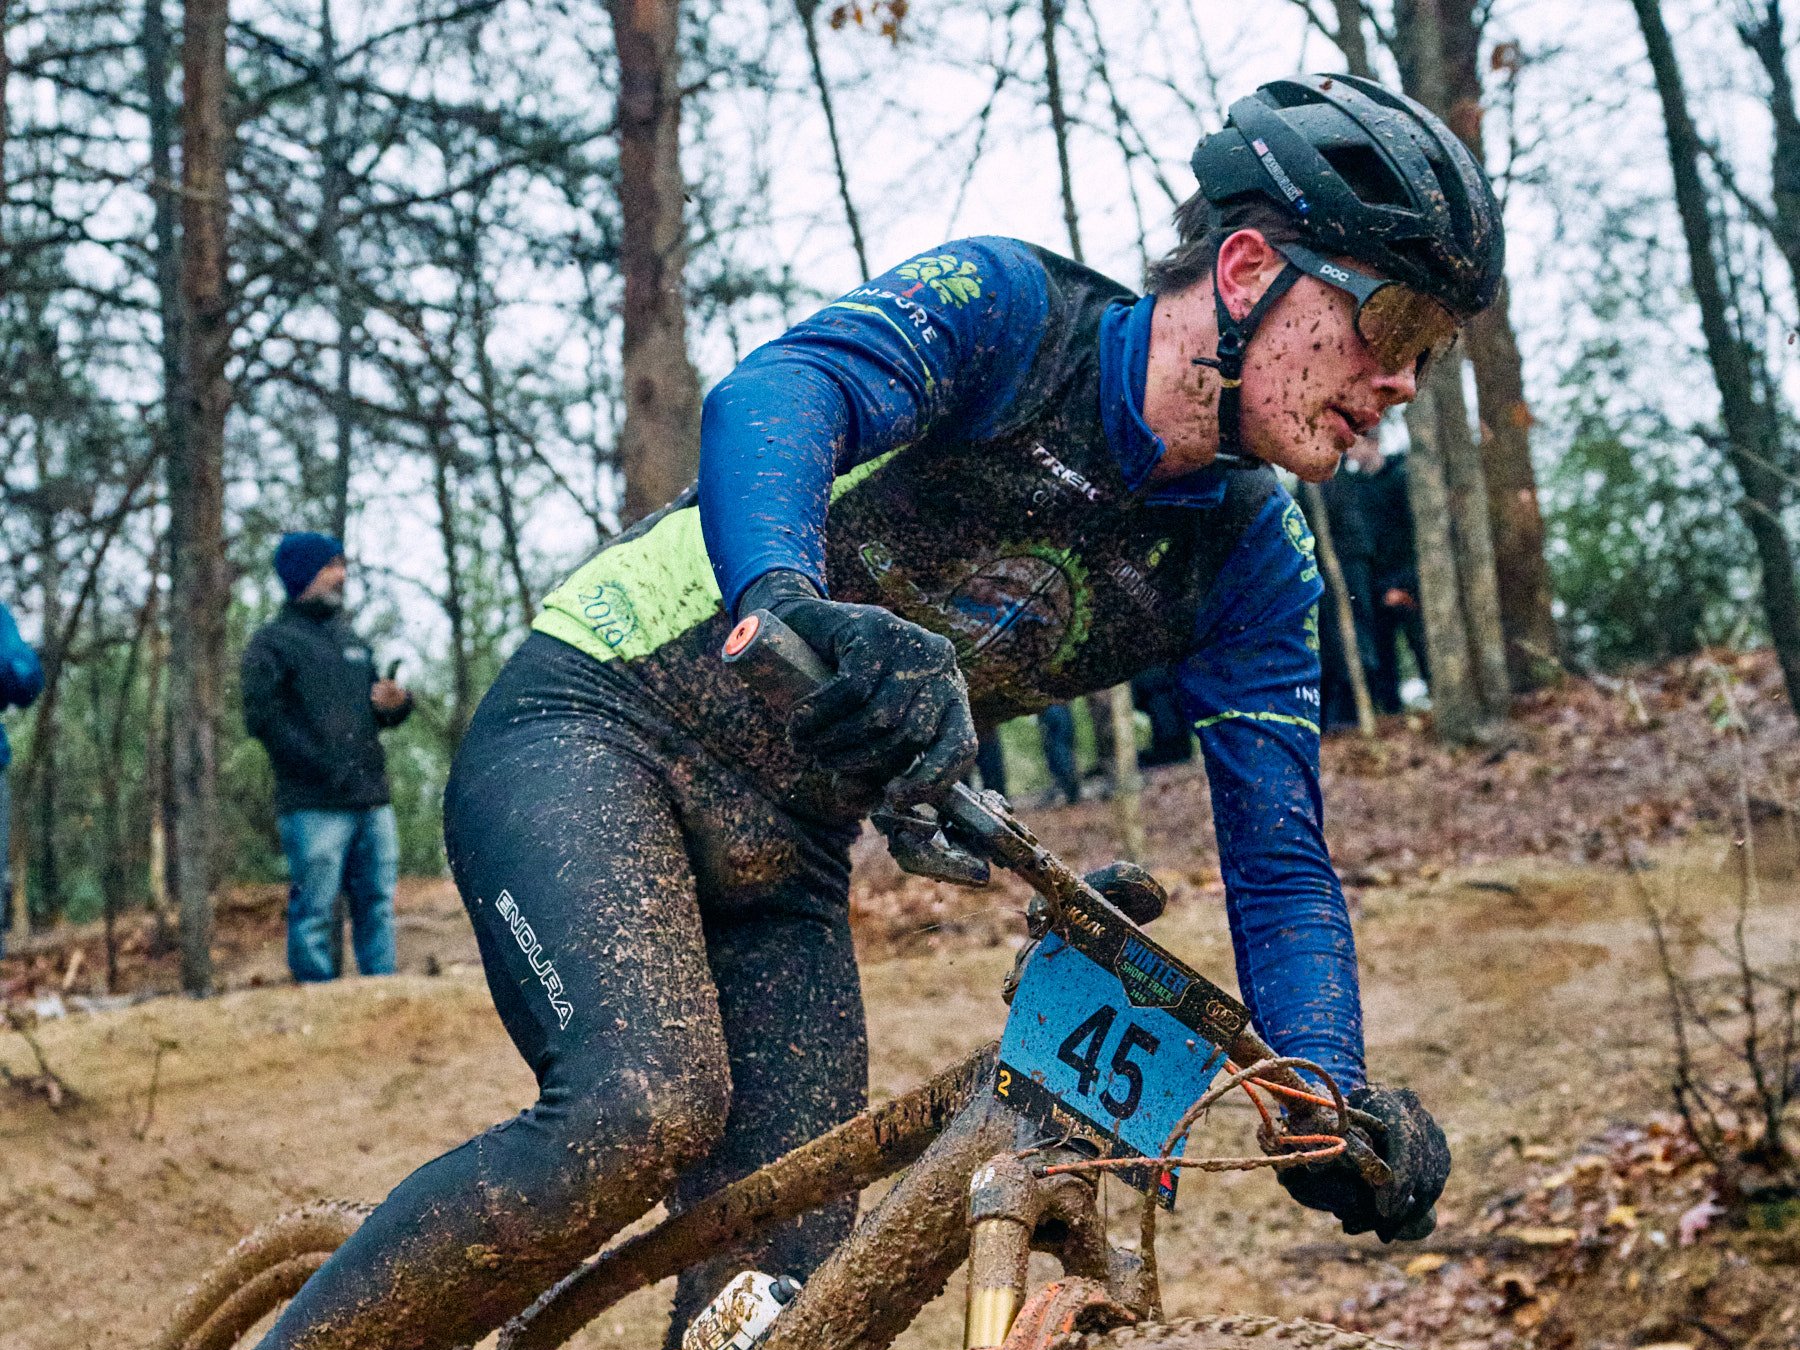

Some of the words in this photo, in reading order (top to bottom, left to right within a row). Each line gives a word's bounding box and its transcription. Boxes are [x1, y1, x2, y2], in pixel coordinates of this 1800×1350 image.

[848, 287, 938, 345] INSURE
[495, 889, 573, 1030] ENDURA
[1120, 961, 1149, 988] SHORT
[1148, 978, 1175, 1002] TRACK
[1122, 936, 1191, 994] WINTER
[997, 1069, 1012, 1097] 2
[1057, 1005, 1161, 1120] 45
